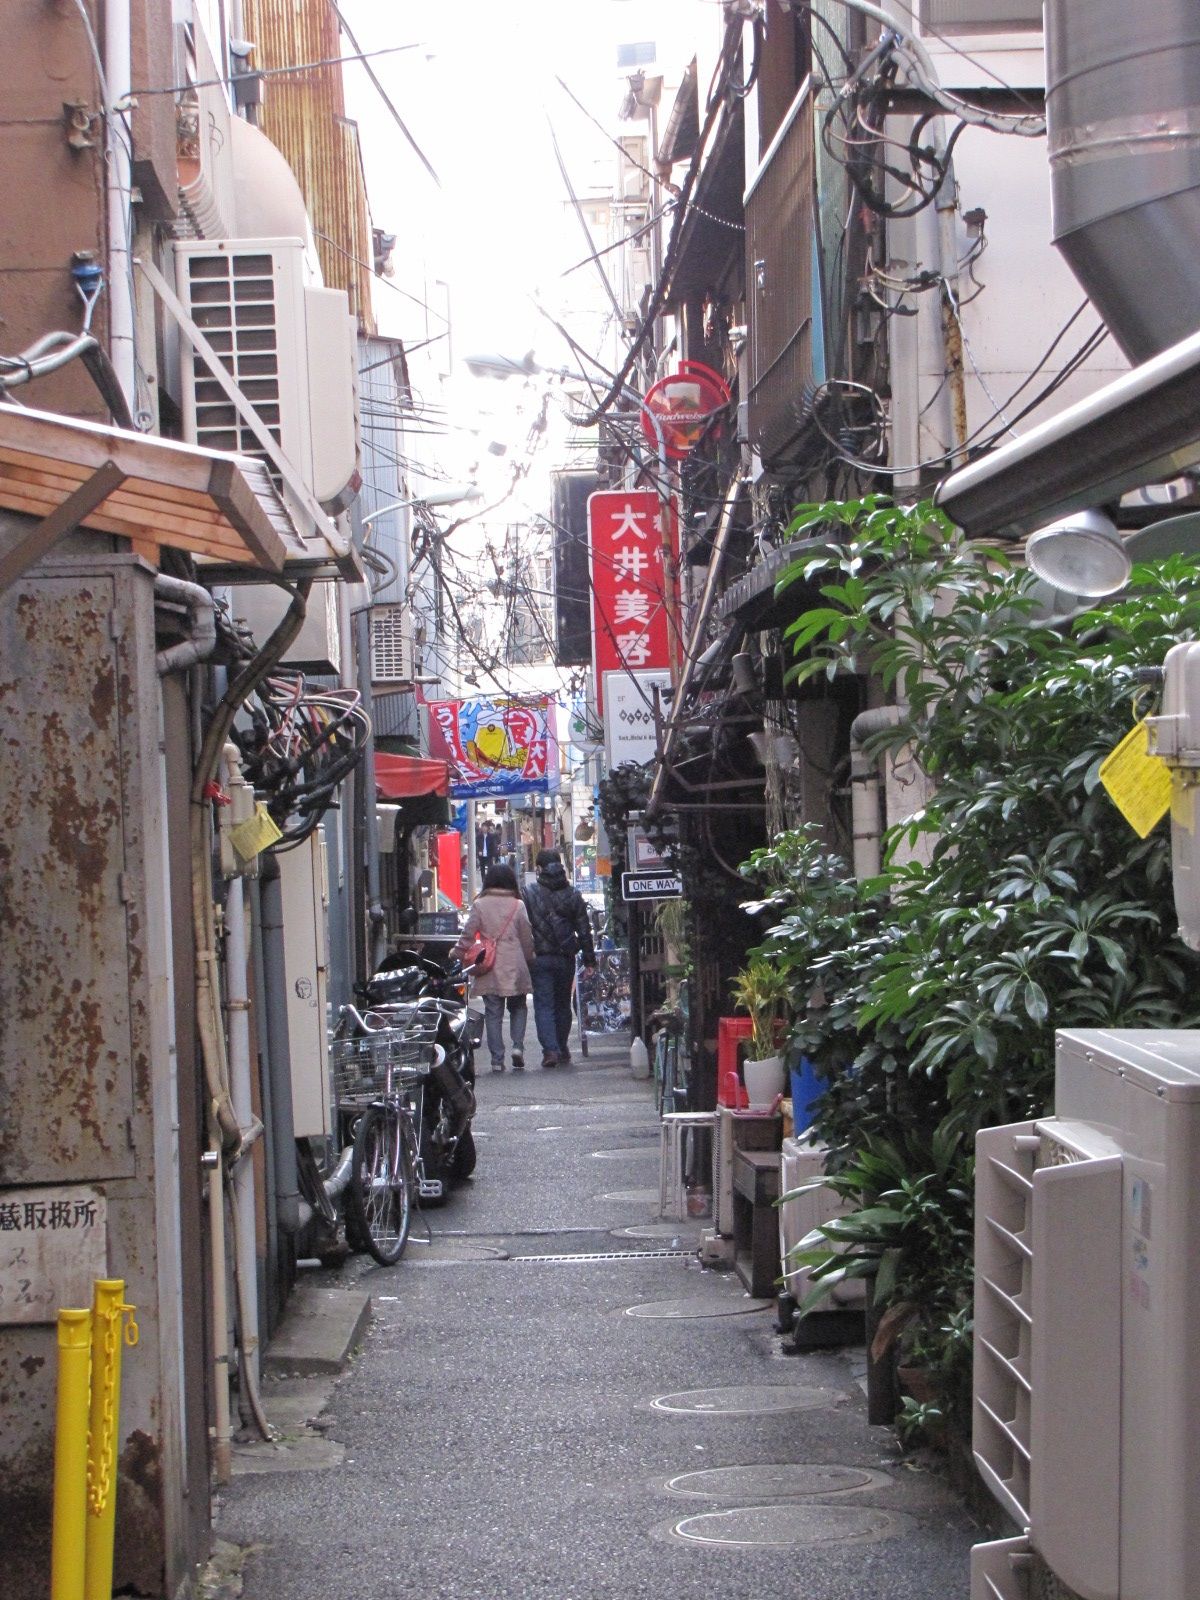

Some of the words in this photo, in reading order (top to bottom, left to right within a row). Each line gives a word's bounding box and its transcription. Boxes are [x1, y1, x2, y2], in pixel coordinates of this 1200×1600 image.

[611, 504, 652, 666] 大井美容
[527, 741, 545, 776] 大入
[632, 881, 653, 891] ONE
[656, 880, 676, 889] WAY
[0, 1200, 97, 1231] 蔵取扱所
